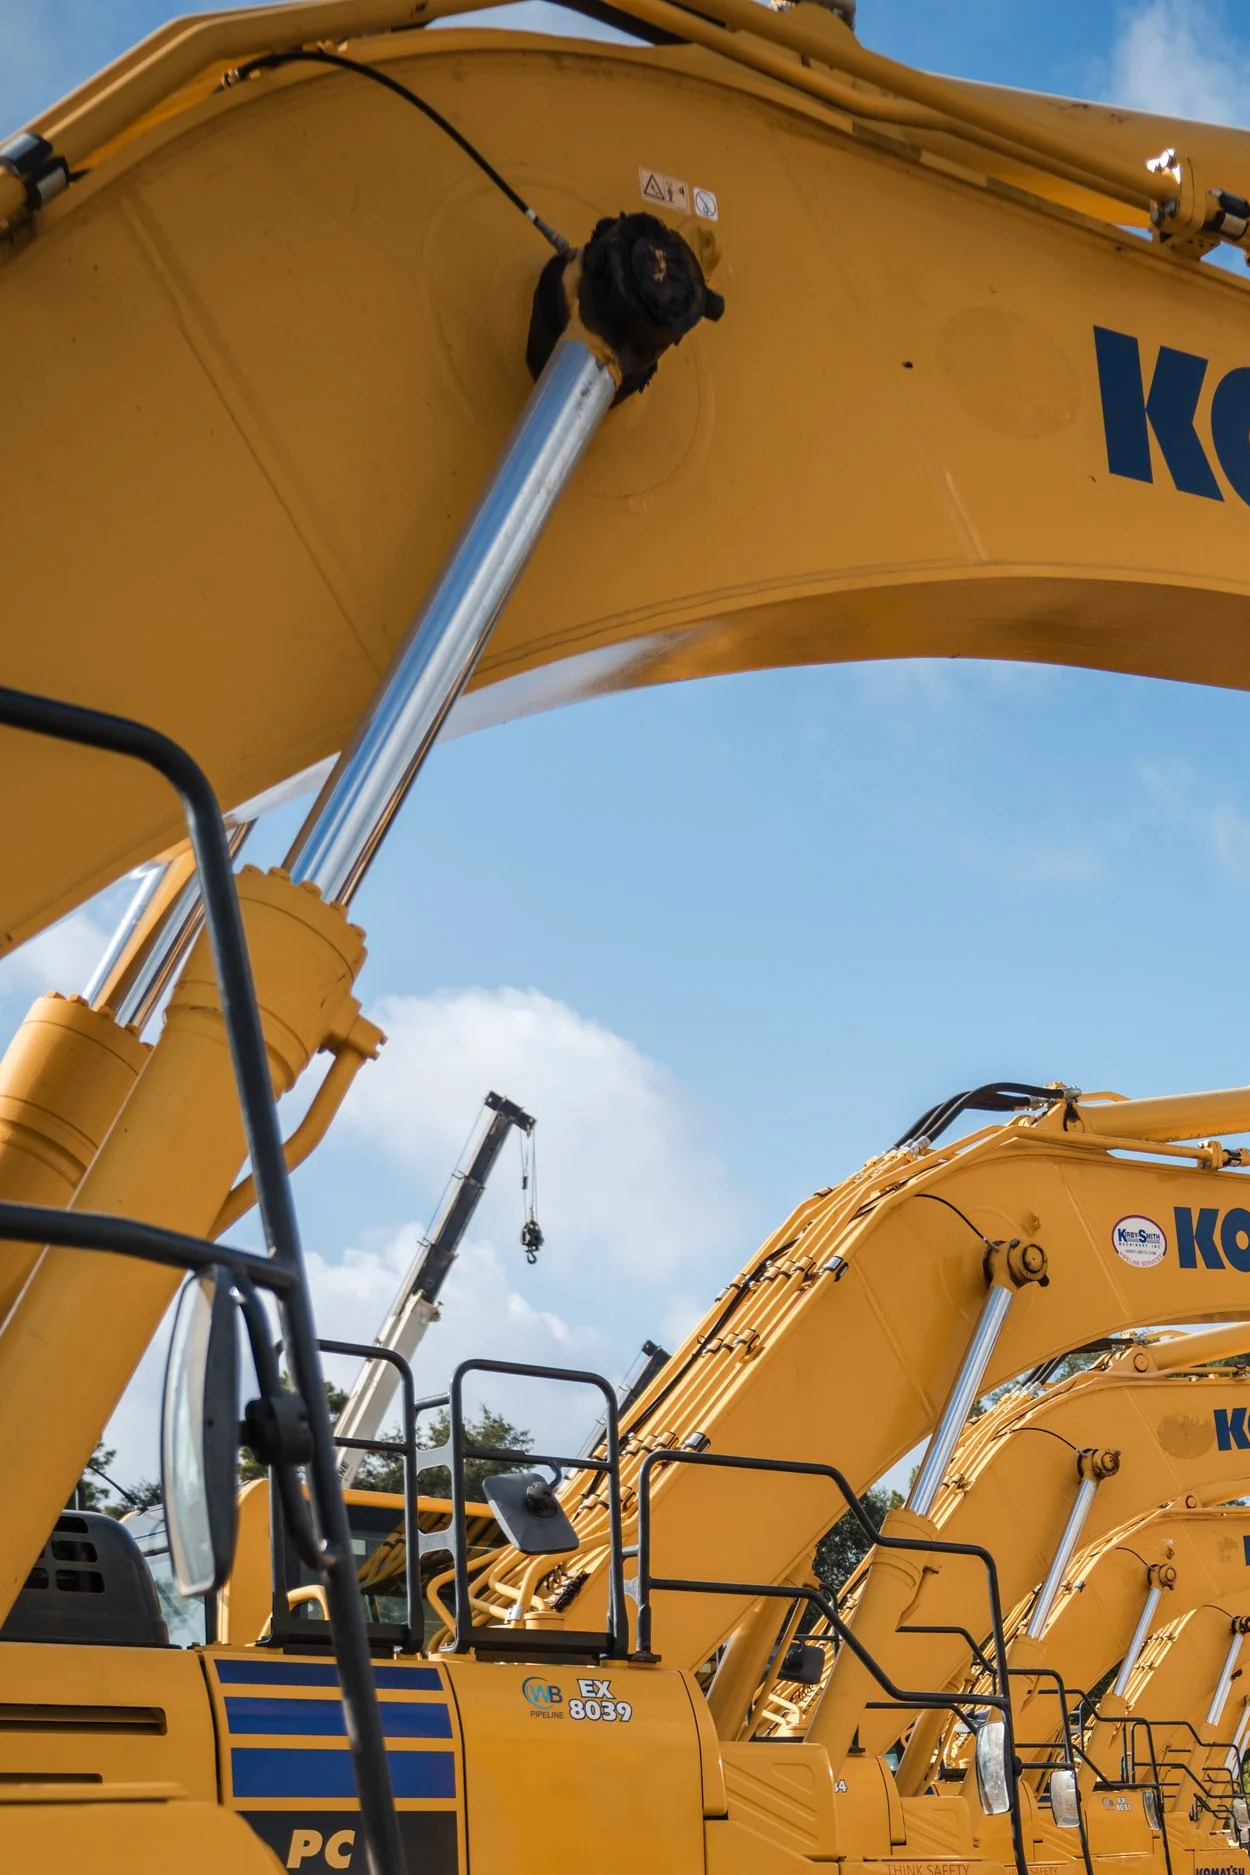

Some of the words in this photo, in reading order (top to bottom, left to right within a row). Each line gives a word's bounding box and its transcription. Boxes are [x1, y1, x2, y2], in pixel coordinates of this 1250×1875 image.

[577, 1679, 616, 1699] EX
[530, 1710, 564, 1719] PIPELINE
[568, 1699, 633, 1722] 8039
[286, 1829, 356, 1869] PC
[1030, 1867, 1058, 1875] SAFETY
